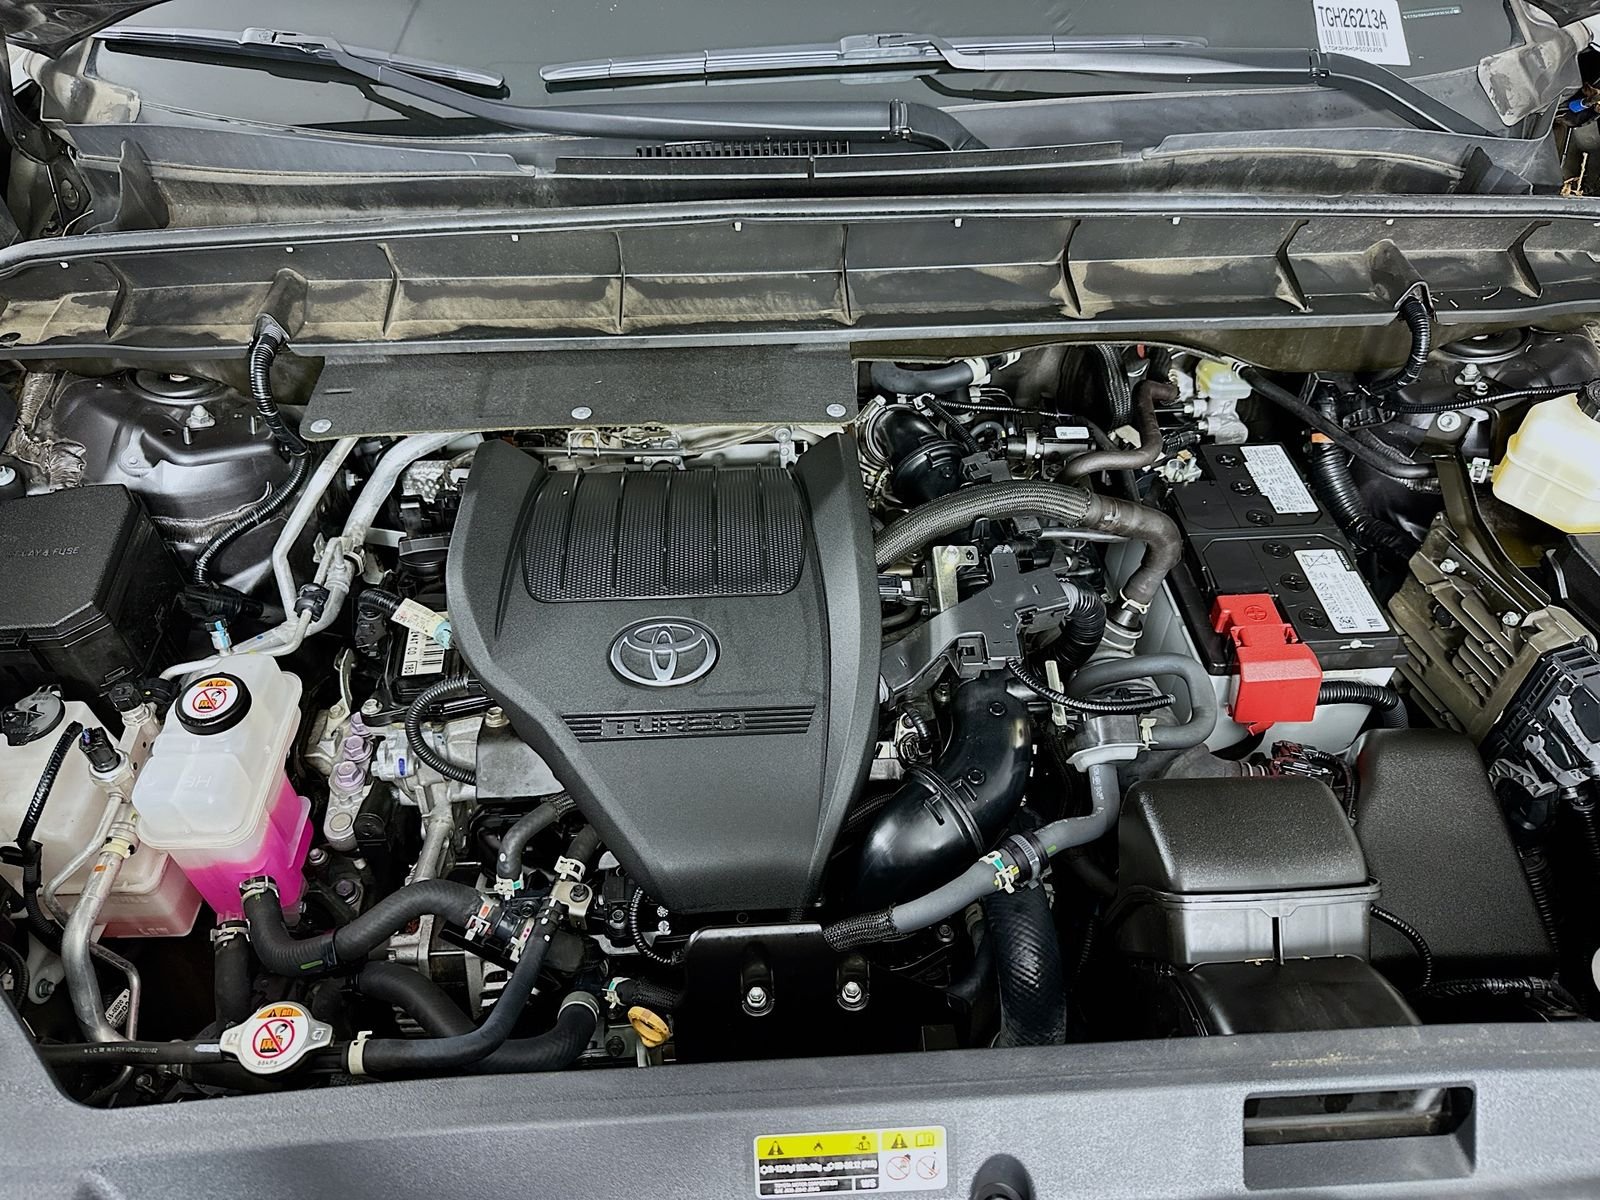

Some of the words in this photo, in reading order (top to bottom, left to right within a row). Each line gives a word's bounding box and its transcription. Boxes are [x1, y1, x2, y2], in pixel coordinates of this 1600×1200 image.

[1318, 6, 1389, 30] TGH26213A
[52, 546, 80, 556] FUSE
[606, 714, 742, 736] TURBO
